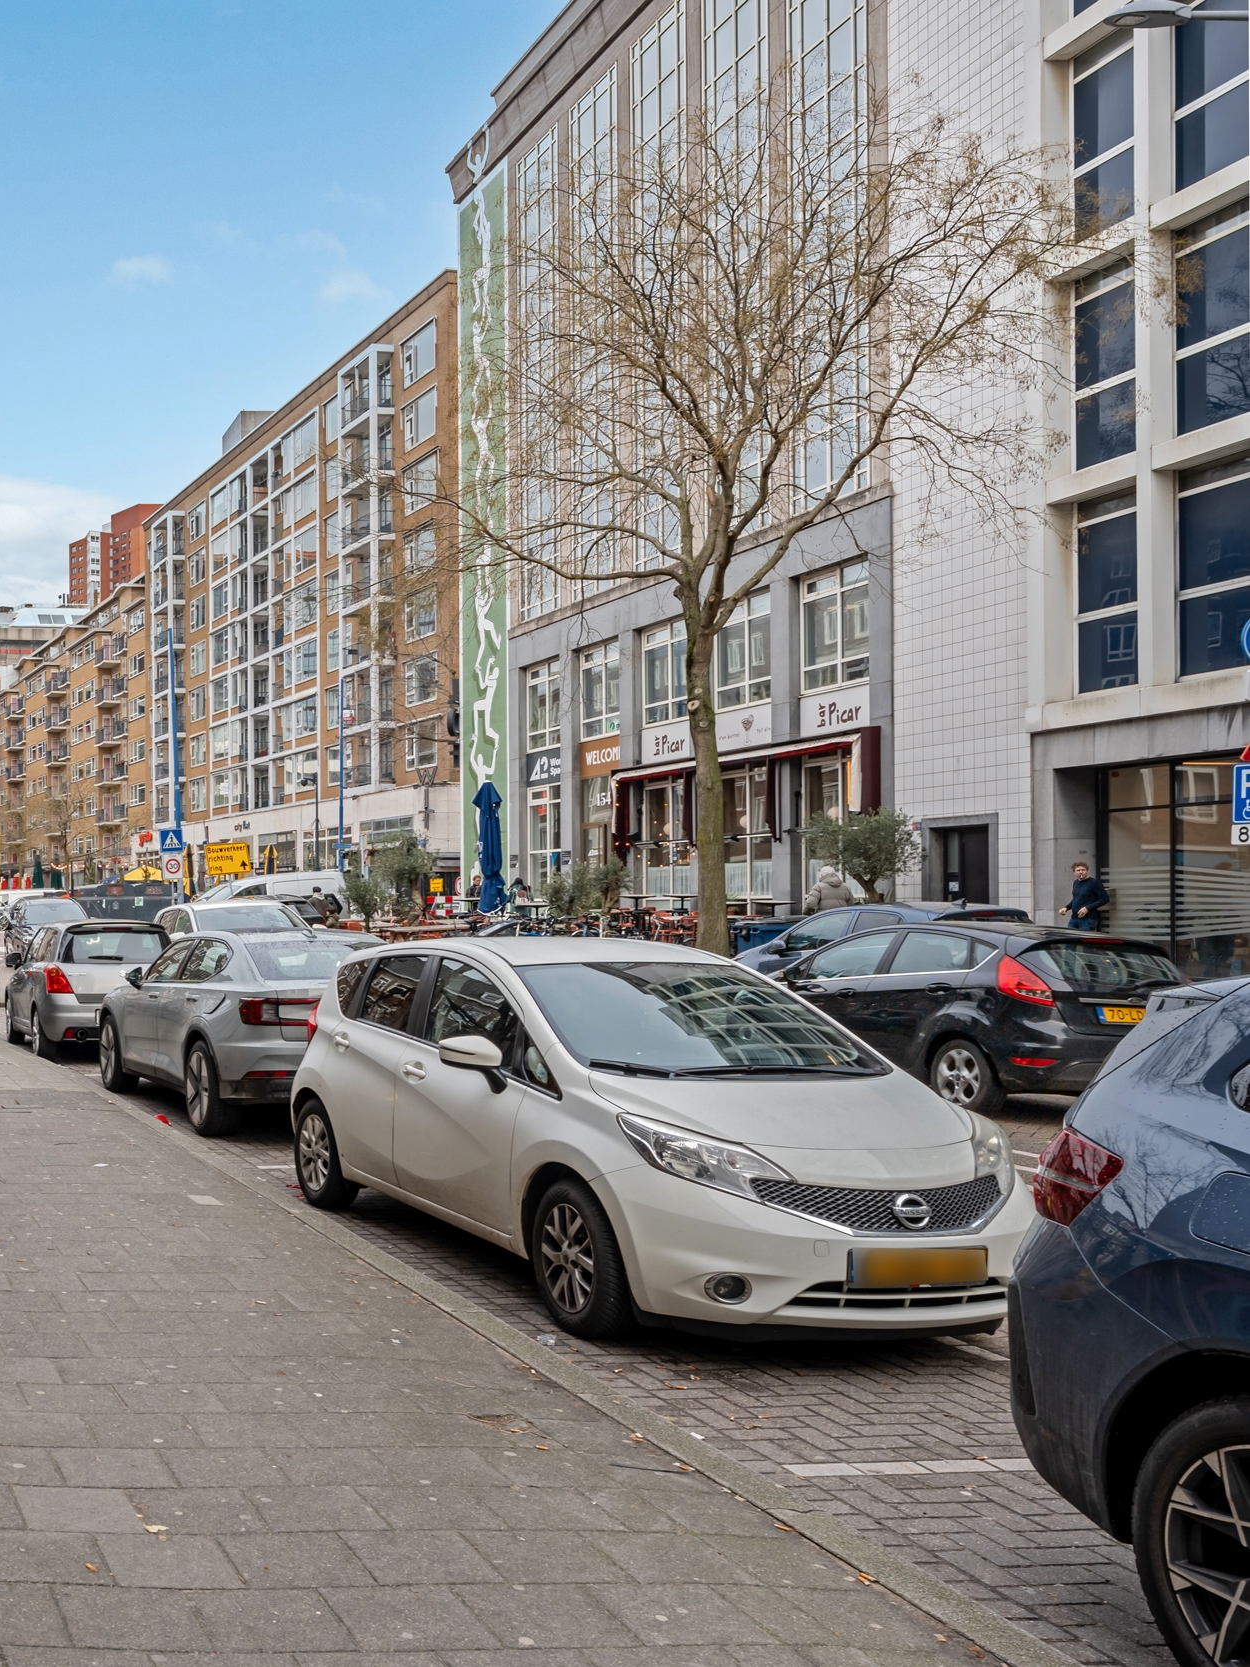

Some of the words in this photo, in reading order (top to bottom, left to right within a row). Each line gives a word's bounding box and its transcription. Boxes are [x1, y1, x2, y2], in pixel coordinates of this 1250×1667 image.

[817, 703, 826, 728] bar
[828, 701, 861, 726] Picar
[661, 734, 686, 755] Picar
[596, 792, 612, 806] 154
[206, 845, 246, 854] Bouwverkeer
[208, 854, 234, 863] richting
[168, 862, 178, 870] 30
